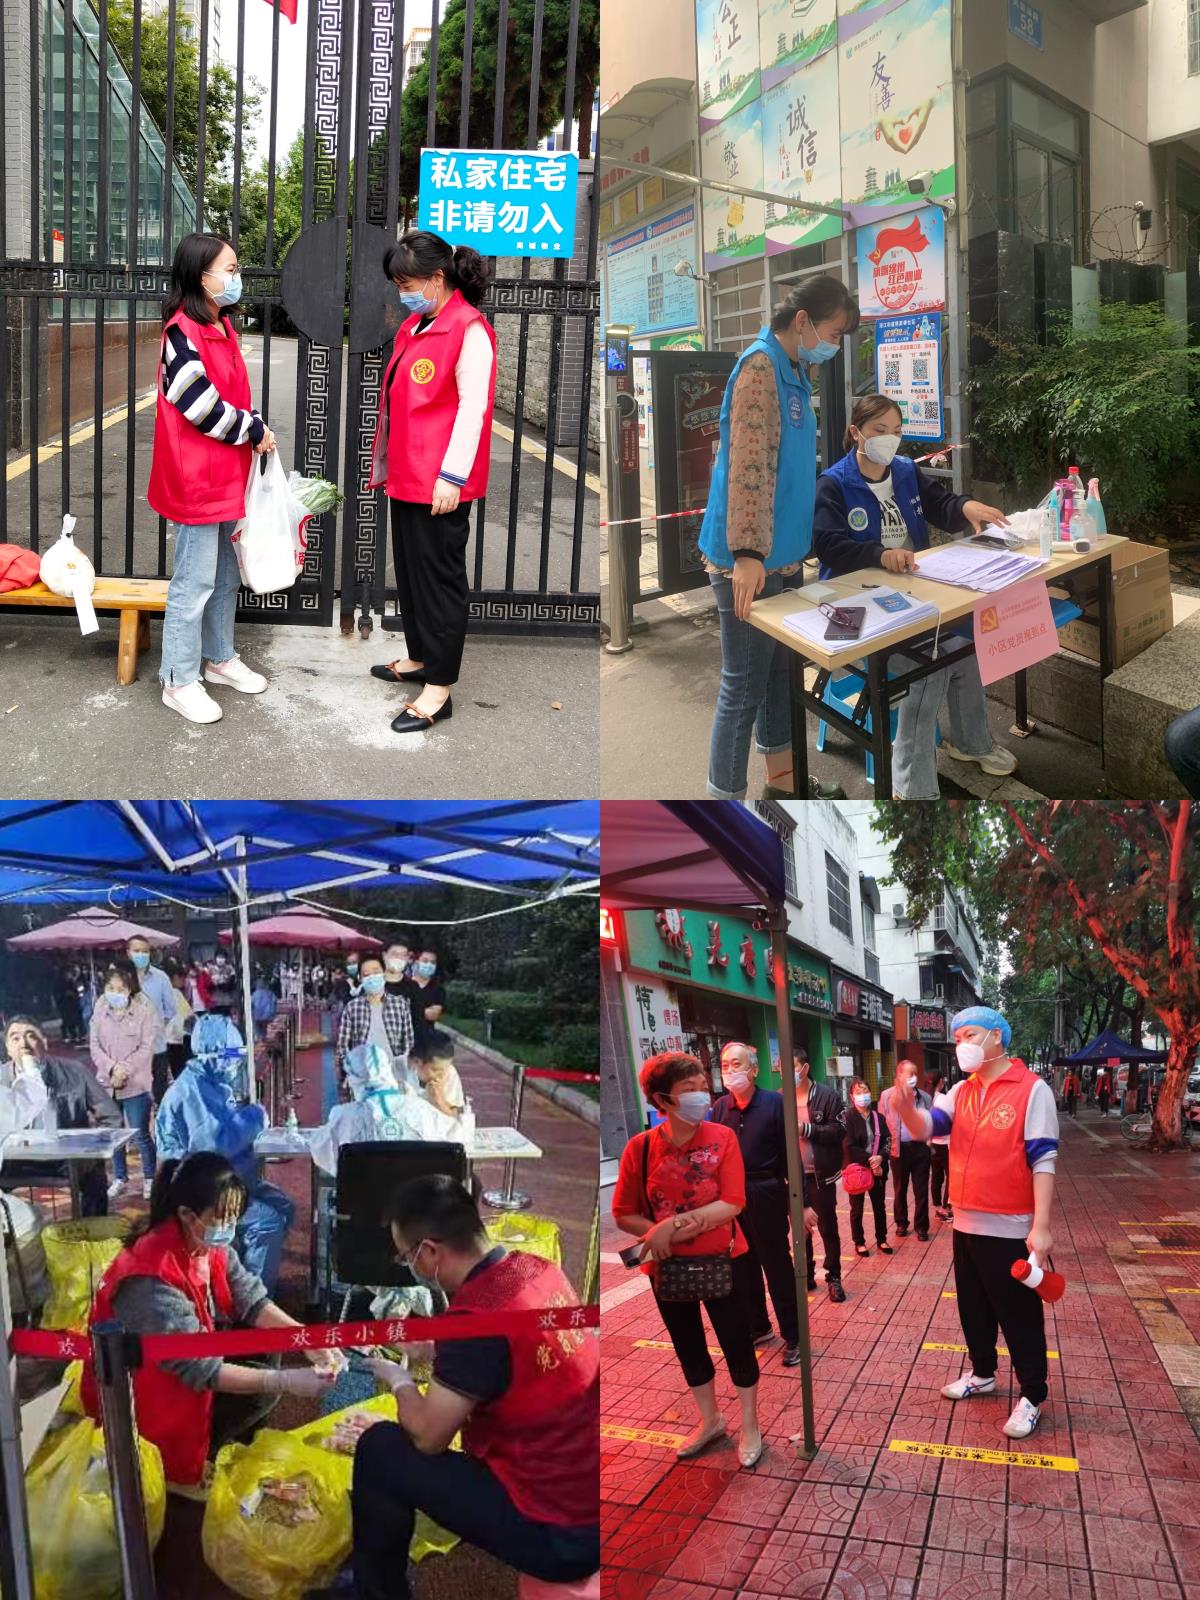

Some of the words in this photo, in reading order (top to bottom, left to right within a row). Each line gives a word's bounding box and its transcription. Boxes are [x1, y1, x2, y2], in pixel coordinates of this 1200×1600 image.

[869, 51, 896, 113] 友善
[786, 95, 818, 170] 诚信
[431, 156, 567, 192] 私家住宅
[428, 198, 564, 235] 非请勿入
[291, 1321, 407, 1347] 欢乐小镇
[537, 1308, 587, 1328] 欢乐
[906, 1445, 1054, 1467] 请您在一米线外等候
